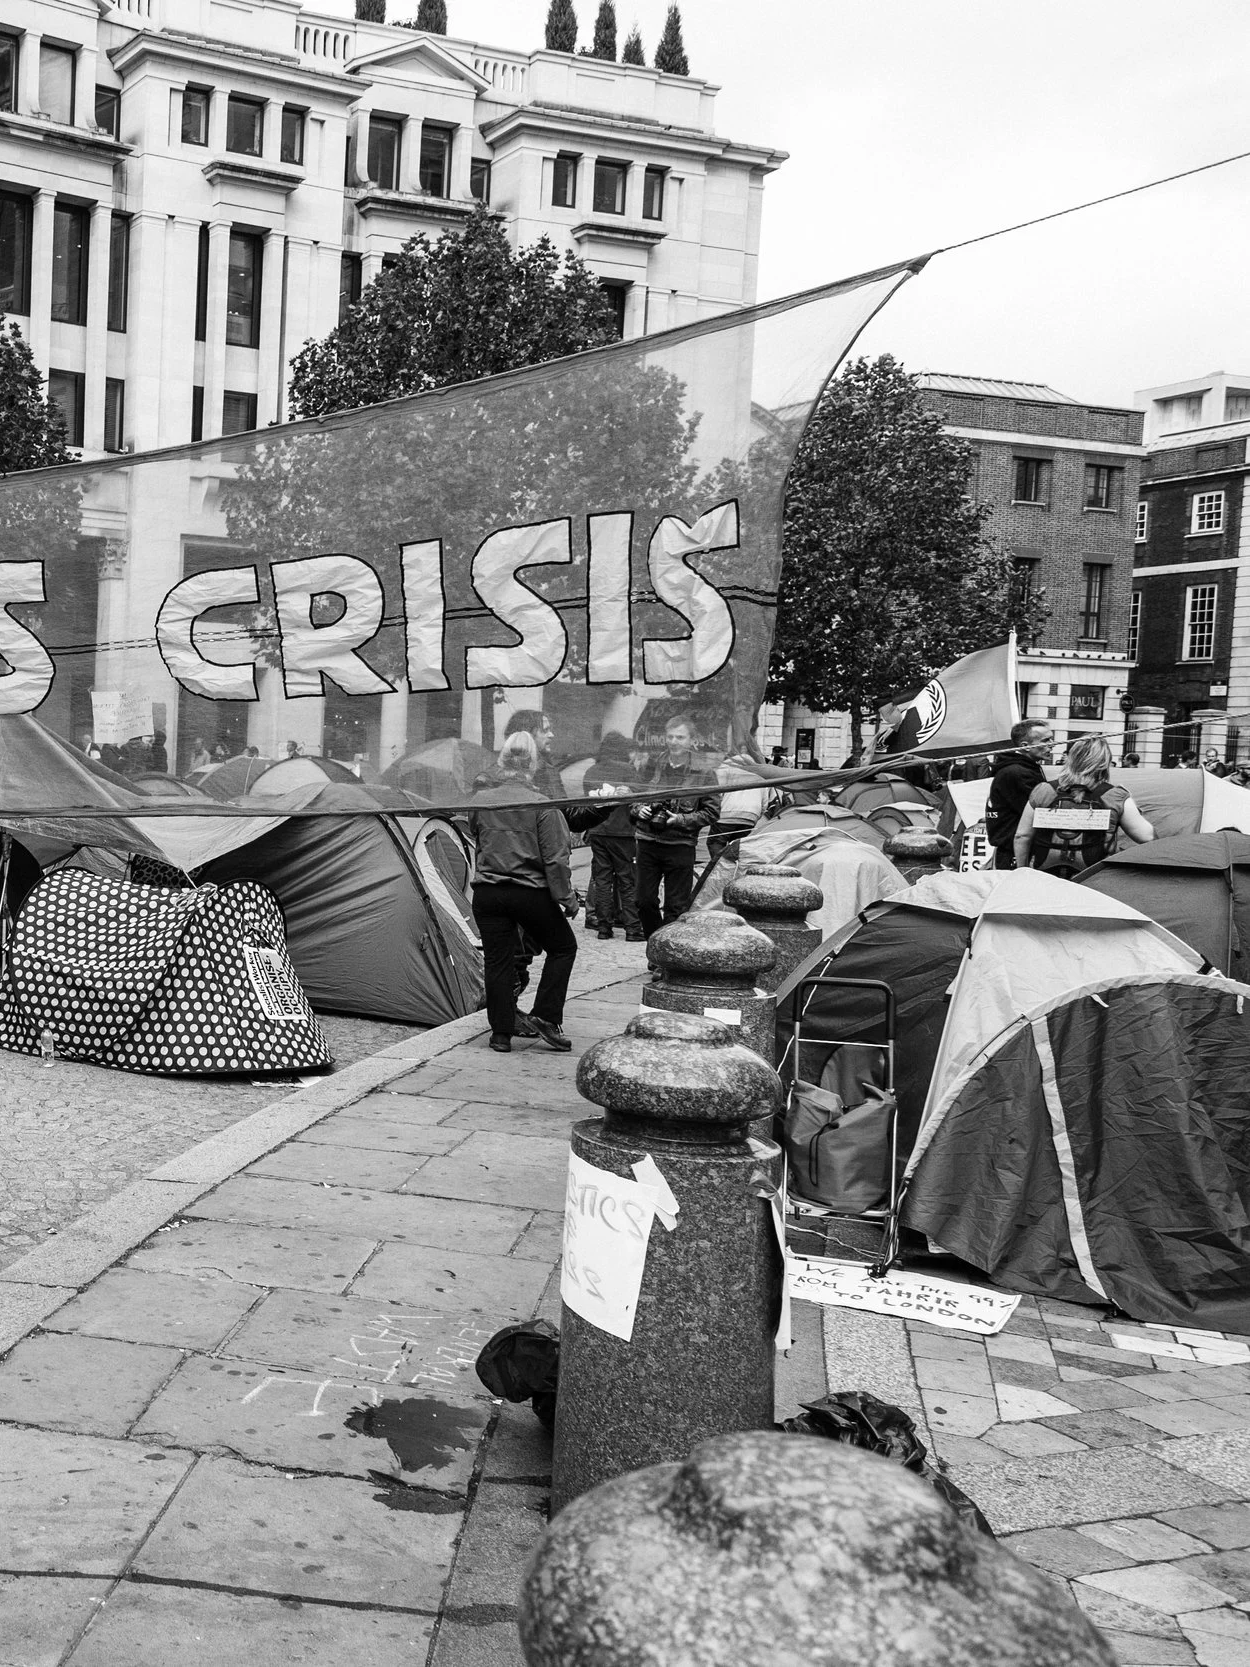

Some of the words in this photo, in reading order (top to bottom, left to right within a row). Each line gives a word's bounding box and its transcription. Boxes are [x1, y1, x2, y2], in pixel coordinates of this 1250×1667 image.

[154, 499, 741, 703] CRISIS
[1070, 696, 1097, 707] PAUL
[248, 951, 260, 982] Worker
[256, 981, 276, 1016] Socialist
[834, 1290, 864, 1300] TO
[883, 1297, 996, 1328] LONDON
[858, 1284, 959, 1309] TAHRIR
